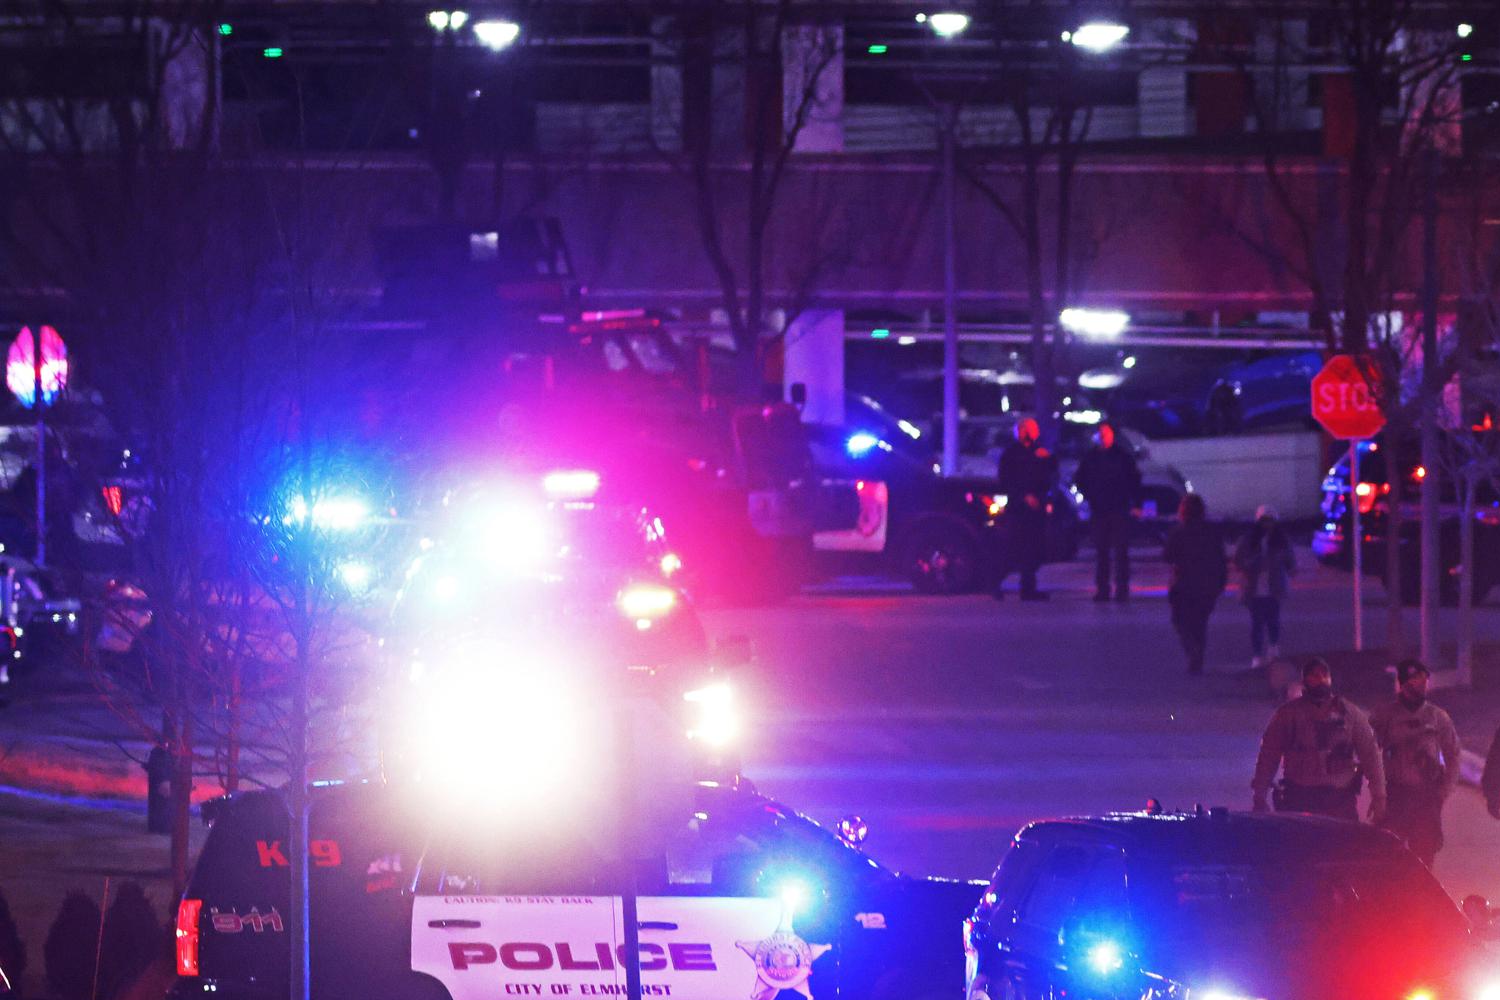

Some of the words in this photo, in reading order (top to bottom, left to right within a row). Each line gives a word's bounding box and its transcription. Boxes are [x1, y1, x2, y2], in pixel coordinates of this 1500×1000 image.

[1320, 383, 1377, 412] STO
[211, 912, 284, 933] 911
[448, 942, 717, 970] POLICE
[505, 983, 542, 995] CITY
[551, 983, 573, 995] OF
[580, 983, 672, 996] ELMHRST
